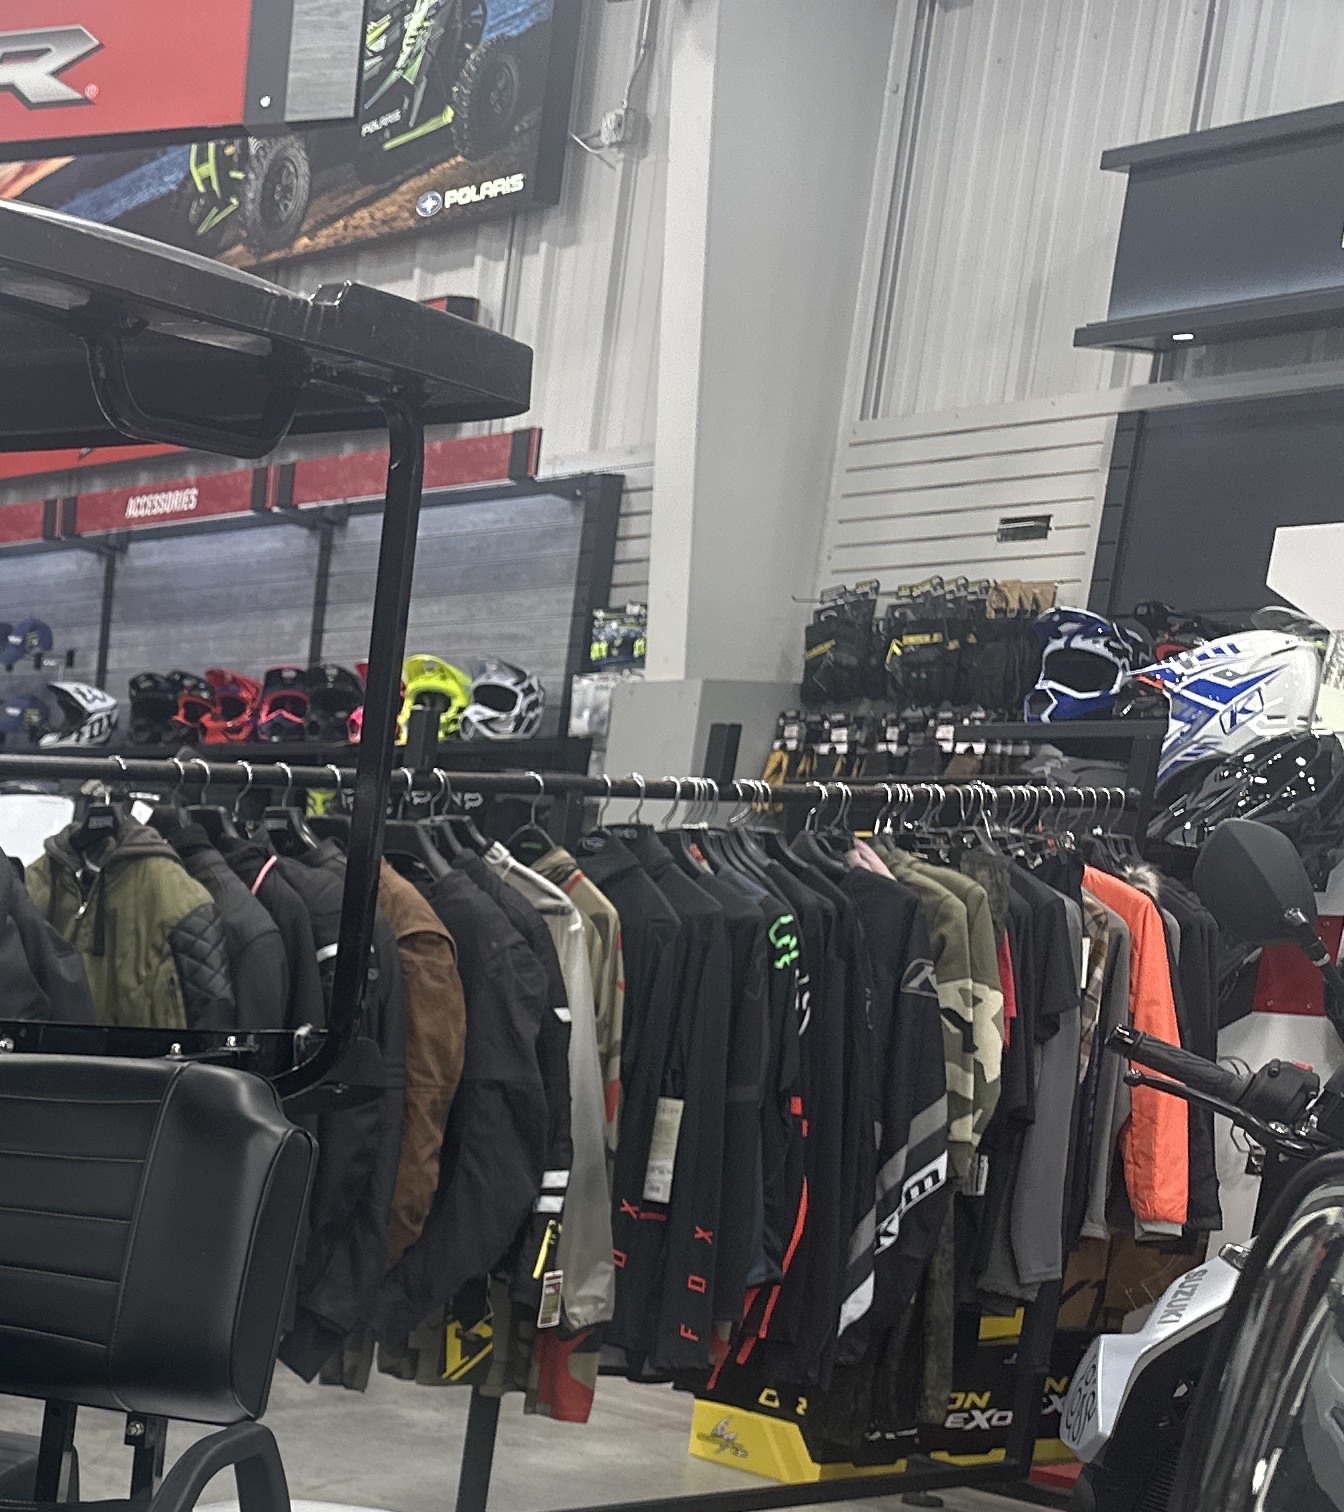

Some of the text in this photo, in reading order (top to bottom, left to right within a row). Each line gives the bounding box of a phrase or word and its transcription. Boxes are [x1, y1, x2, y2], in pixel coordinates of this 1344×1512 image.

[444, 173, 524, 208] POLARIS
[124, 487, 199, 519] ACCESSORIES
[1157, 1268, 1208, 1325] SUZUKI
